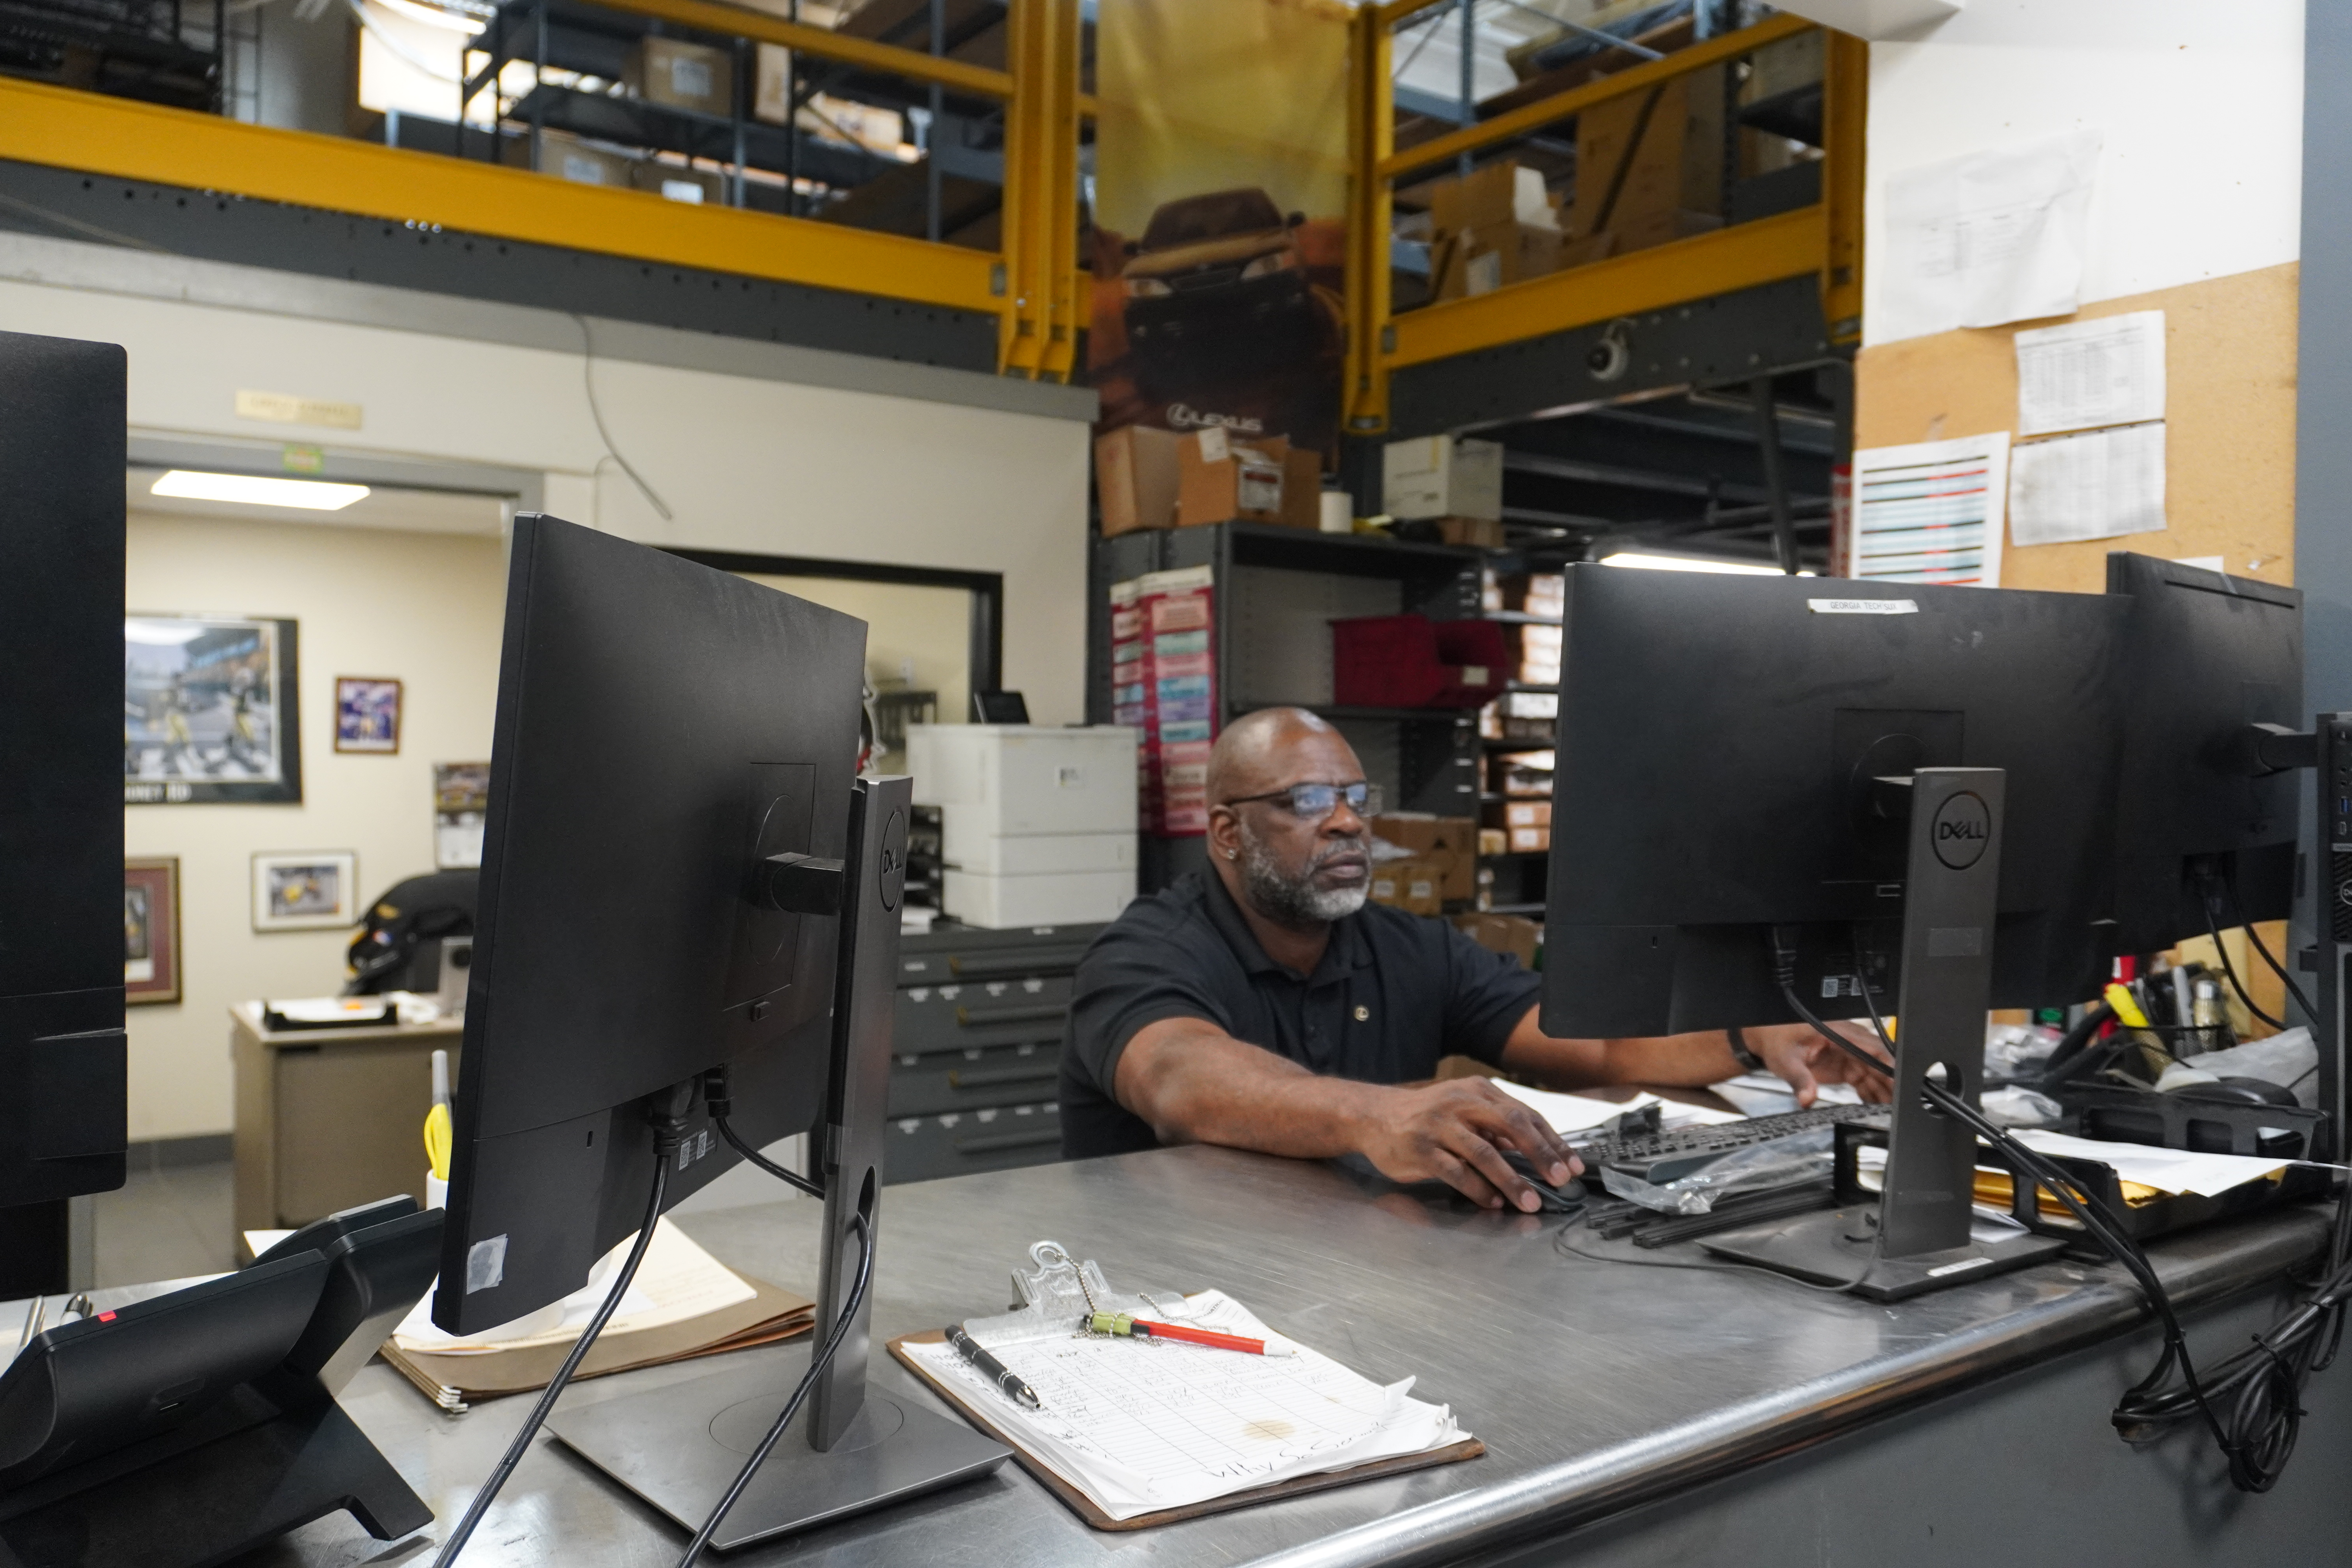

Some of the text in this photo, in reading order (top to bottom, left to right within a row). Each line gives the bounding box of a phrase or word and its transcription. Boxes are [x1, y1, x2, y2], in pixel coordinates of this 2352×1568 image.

[1830, 601, 1861, 610] GEORGIA
[1884, 603, 1897, 611] SUX
[1940, 821, 1984, 840] DELL
[883, 846, 902, 875] DELL
[1201, 1462, 1274, 1477] Why
[1279, 1449, 1313, 1465] So
